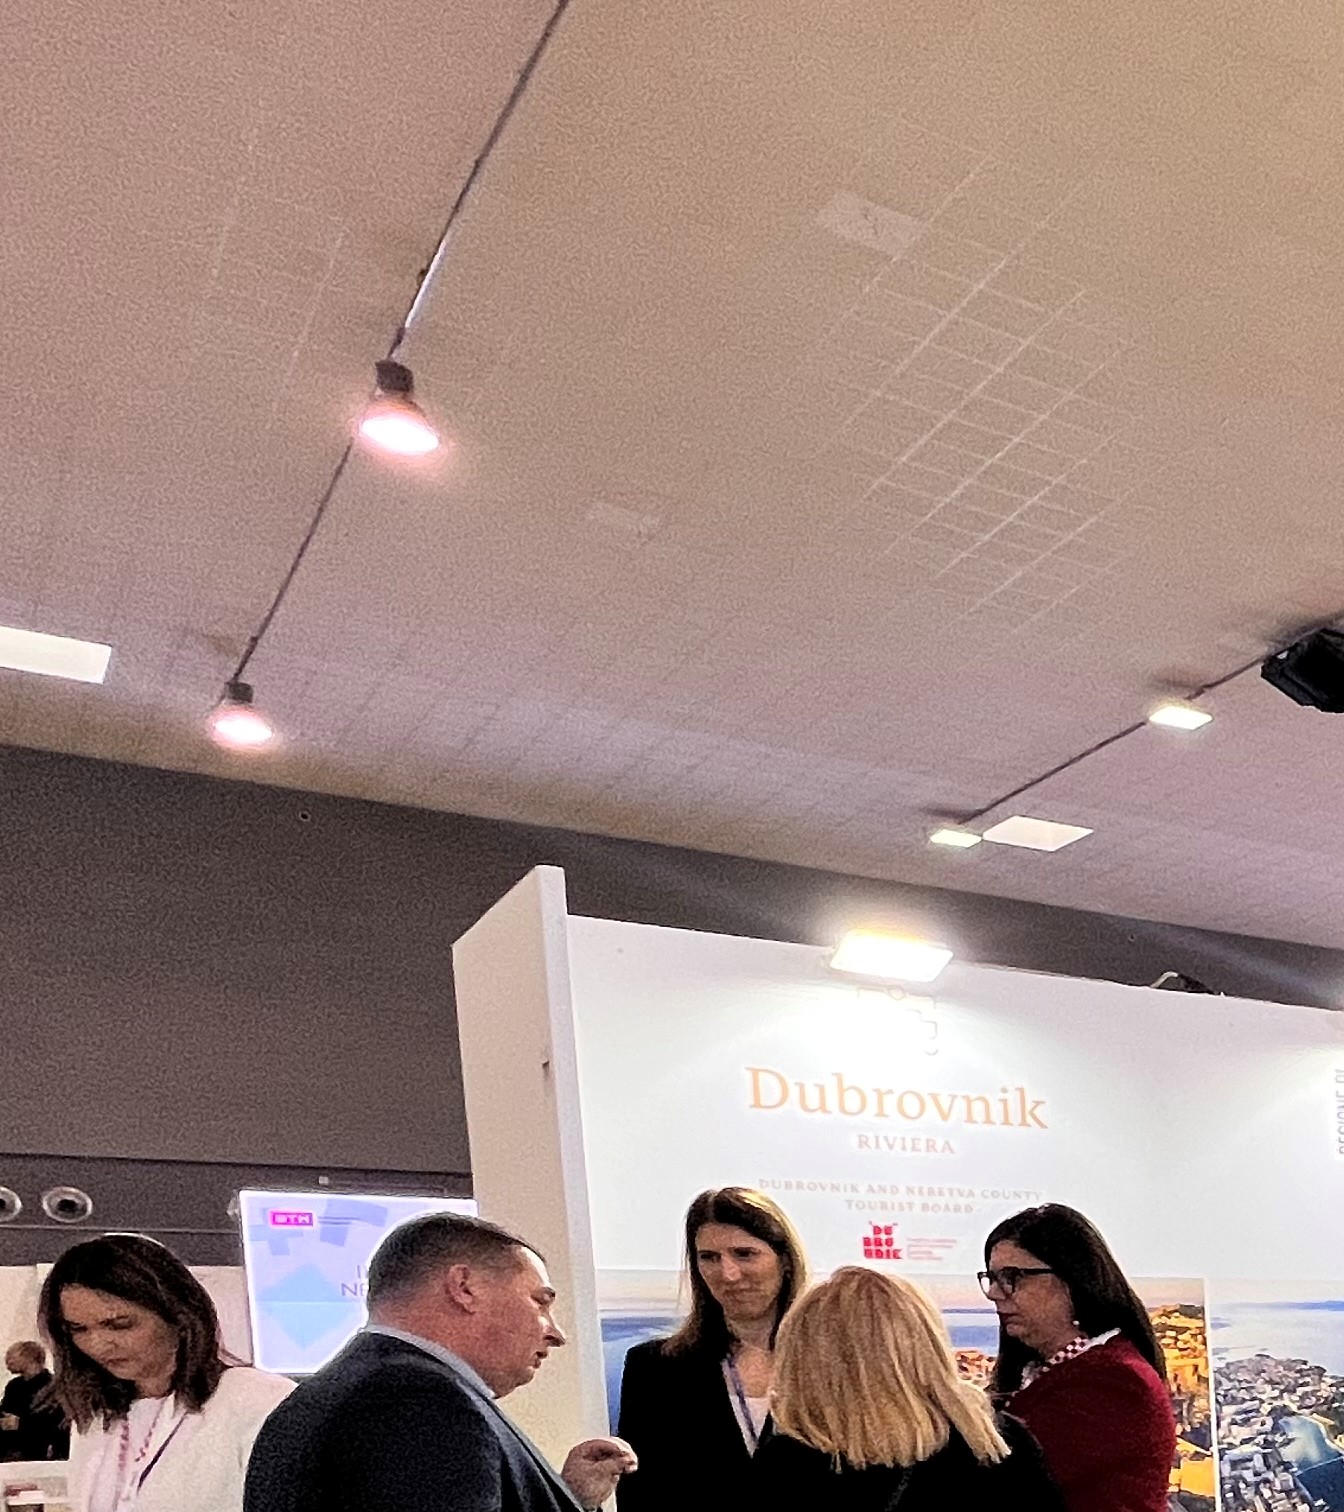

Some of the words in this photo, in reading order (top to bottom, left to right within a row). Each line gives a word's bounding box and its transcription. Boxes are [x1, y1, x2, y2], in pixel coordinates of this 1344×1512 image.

[746, 1066, 1048, 1129] Dubrovnik
[857, 1133, 956, 1154] RIVIERA
[758, 1178, 860, 1195] DUBROVNIK
[866, 1182, 900, 1197] AND
[905, 1184, 976, 1199] NERETVA
[980, 1188, 1042, 1202] COUNTY
[846, 1199, 915, 1213] TOURIST
[921, 1200, 974, 1214] BOARD
